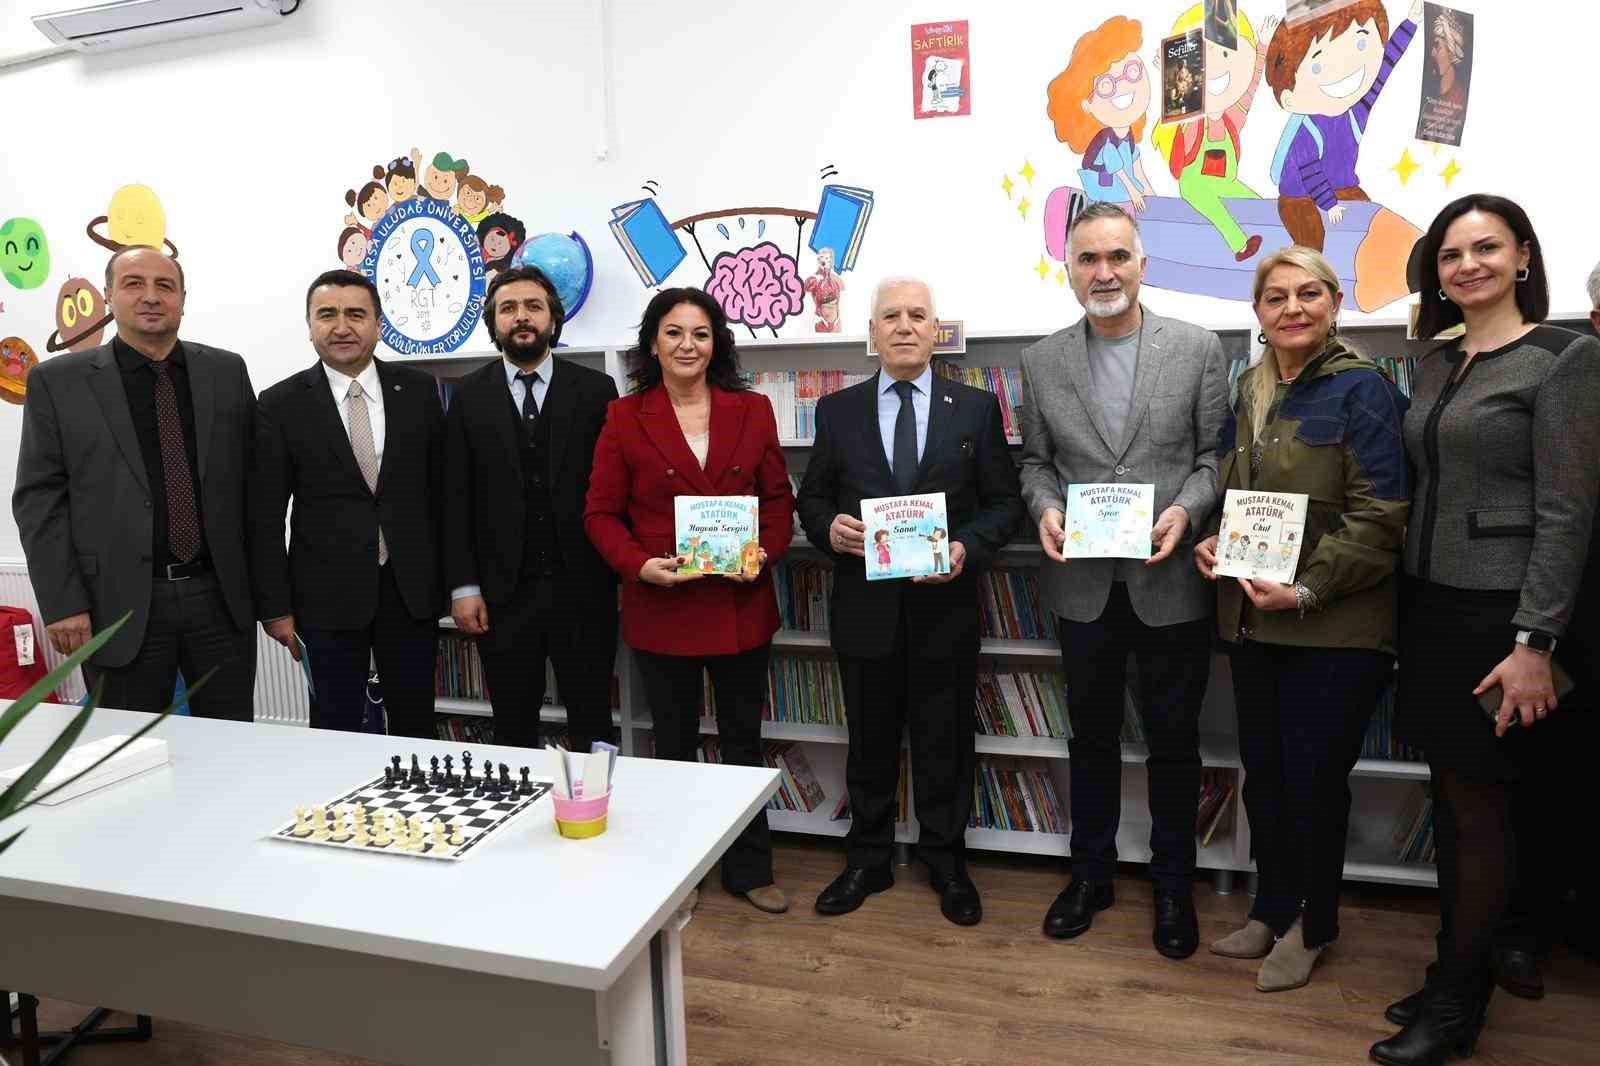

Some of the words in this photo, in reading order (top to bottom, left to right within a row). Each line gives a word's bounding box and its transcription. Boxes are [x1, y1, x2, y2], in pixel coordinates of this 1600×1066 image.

[379, 199, 423, 237] ULUDAĞ
[1080, 487, 1115, 498] MUSTAFA
[1117, 487, 1142, 498] KEMAL
[690, 500, 722, 512] MUSTAFA
[873, 500, 908, 513] MUSTAFA
[910, 499, 934, 509] KEMAL
[1090, 495, 1132, 505] ATATÜRK
[1236, 496, 1270, 506] MUSTAFA
[1271, 495, 1295, 511] KEMAL
[700, 508, 738, 520] ATATÜRK
[885, 508, 925, 521] ATATÜRK
[1245, 506, 1284, 519] ATATÜRK
